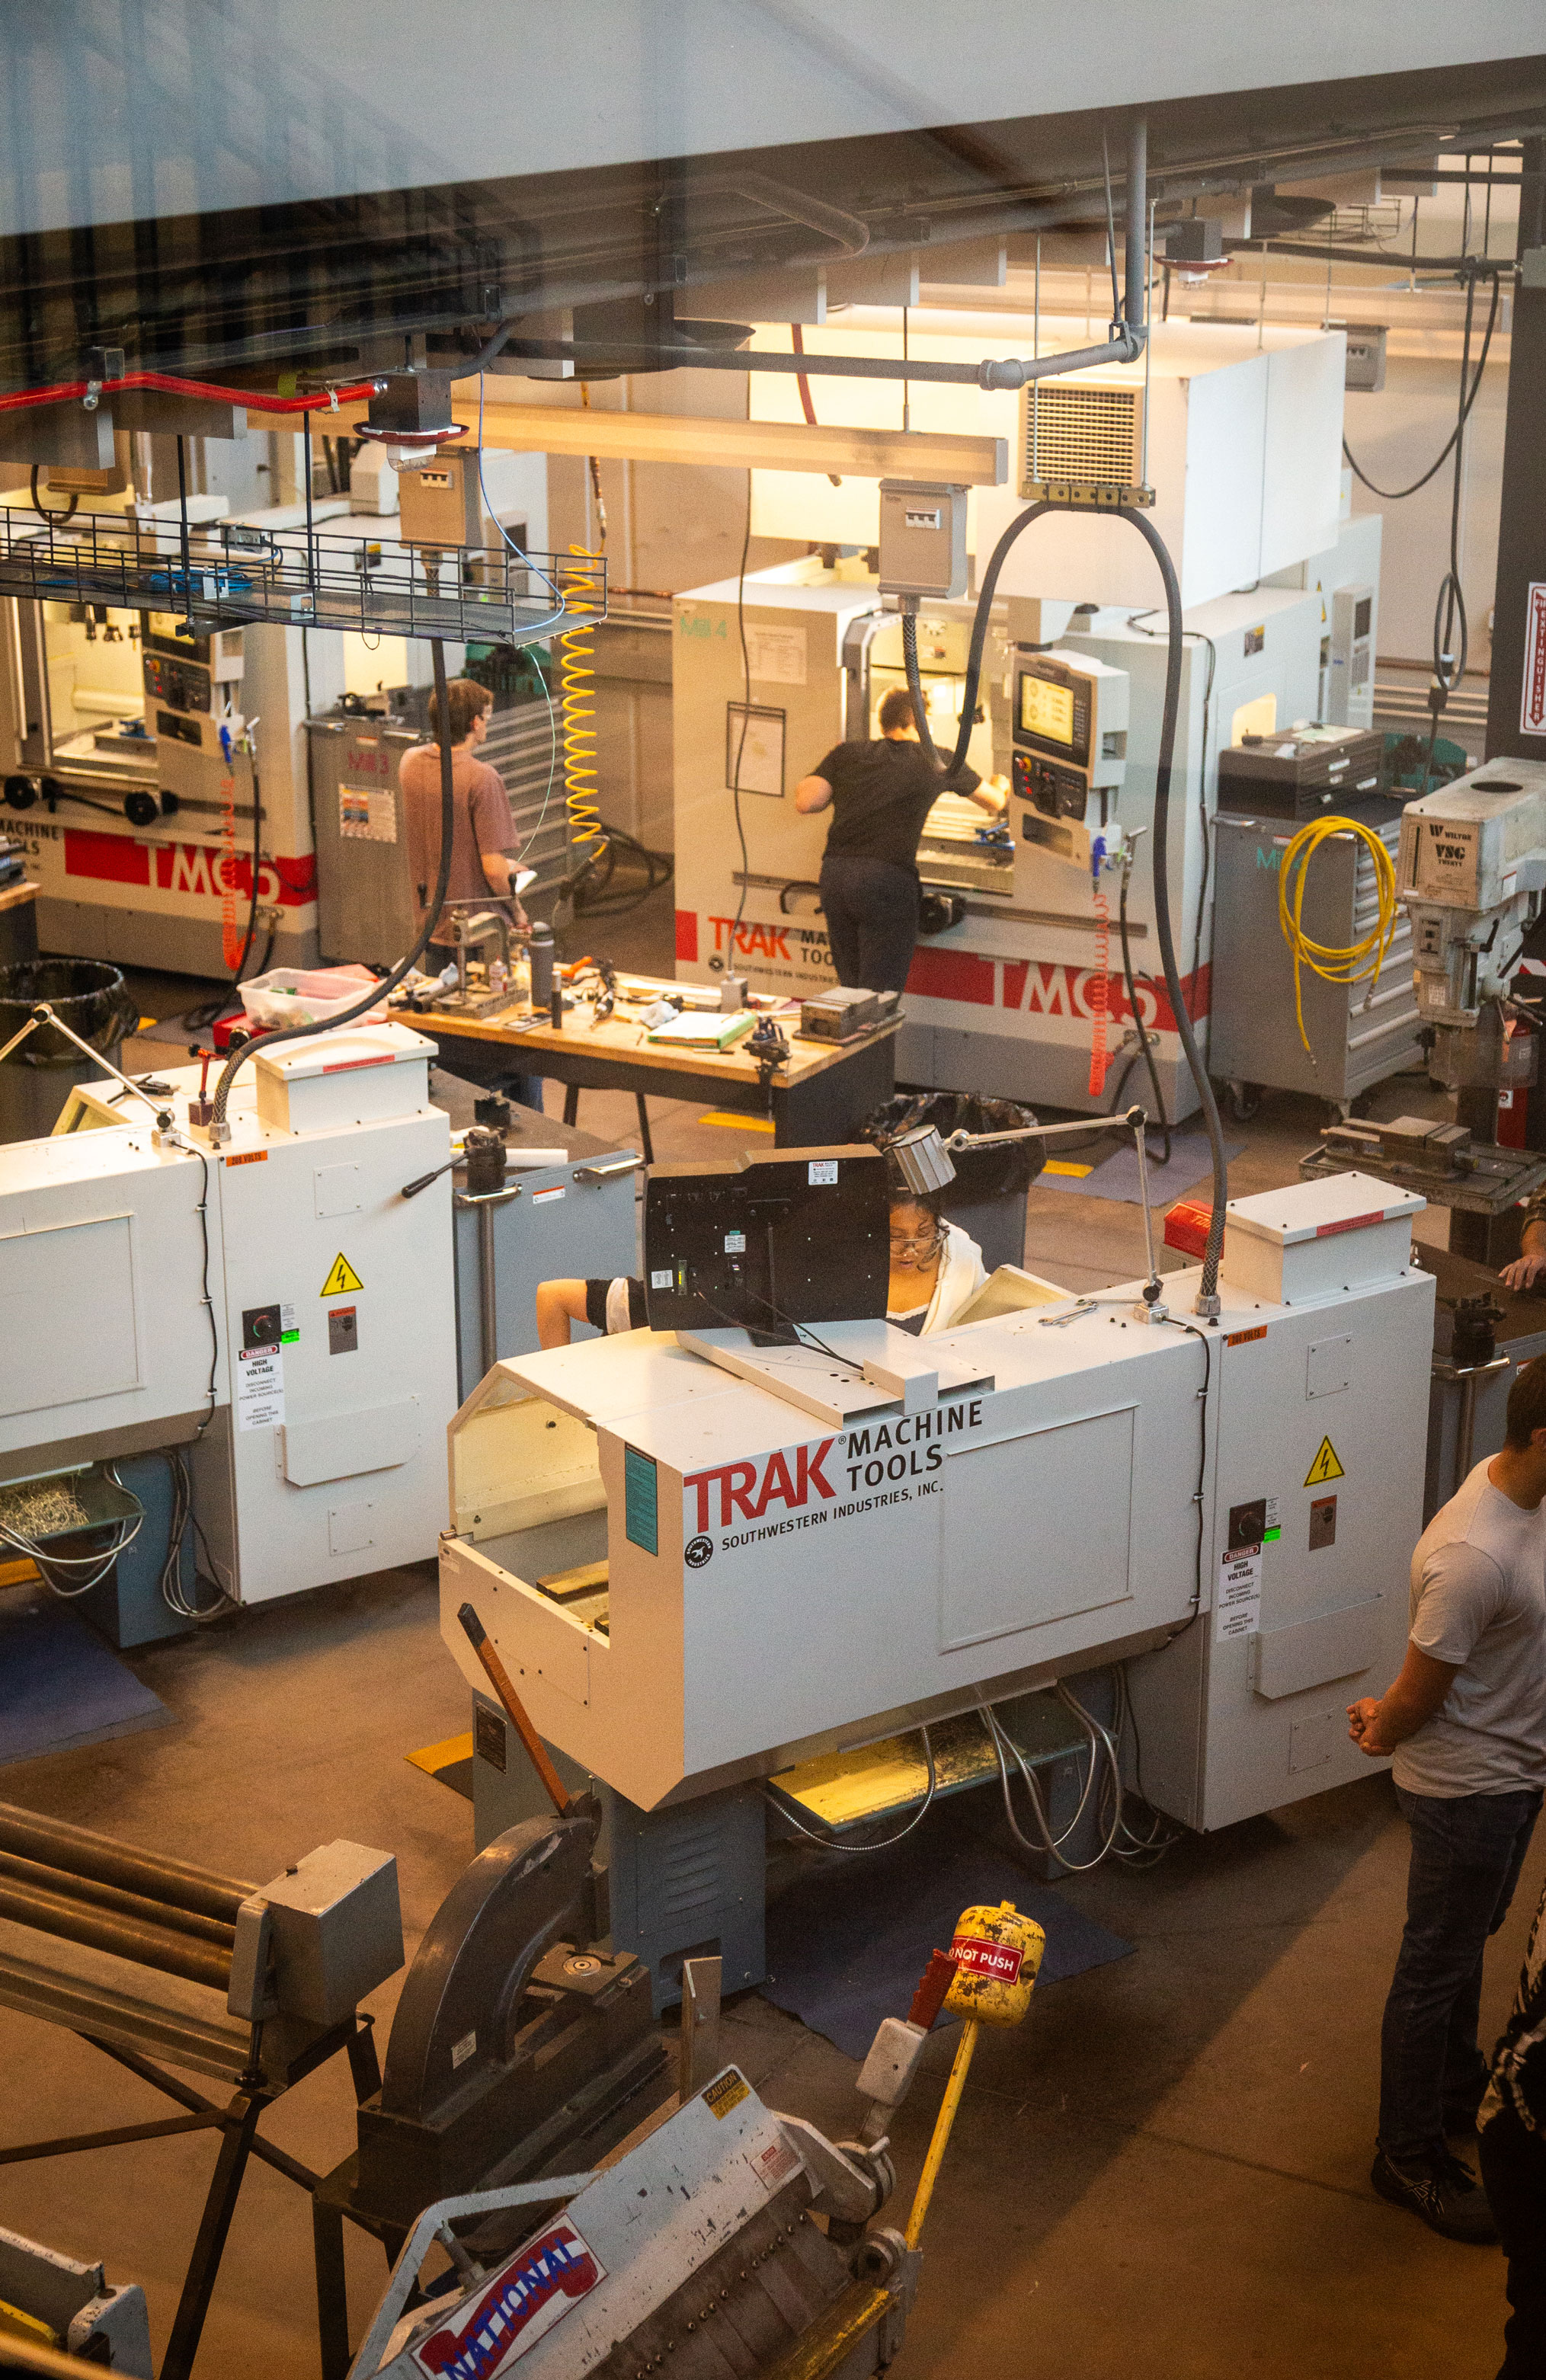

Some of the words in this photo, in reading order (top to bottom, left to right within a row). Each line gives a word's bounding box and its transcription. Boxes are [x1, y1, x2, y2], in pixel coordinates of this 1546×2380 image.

[1534, 610, 1546, 721] EXTINGUISHER
[708, 916, 792, 961] TRAK
[246, 1347, 273, 1358] DANGER
[246, 1365, 274, 1376] VOLTAGE
[245, 1378, 276, 1387] DISCONNECT
[245, 1412, 267, 1420] OPENING
[683, 1437, 837, 1534] TRAK
[847, 1400, 983, 1459] MACHINE
[847, 1444, 943, 1492] TOOLS
[721, 1511, 827, 1551] SOUTHWESTERN
[833, 1488, 913, 1521] INDUSTRIES,
[917, 1480, 943, 1497] INC.
[1229, 1548, 1254, 1559] DANGER
[1234, 1560, 1248, 1571] HIGH
[1228, 1568, 1253, 1581] VOLTAGE
[1225, 1582, 1254, 1595] DISCONNECT
[1228, 1590, 1250, 1600] INCOMING
[1219, 1601, 1235, 1609] POWER
[1230, 1613, 1248, 1622] BEFORE
[1223, 1620, 1243, 1630] OPENING
[1228, 1626, 1248, 1635] CABINET
[955, 1948, 979, 1962] NOT
[980, 1953, 1014, 1972] PUSH
[706, 2072, 738, 2103] CAUTION
[440, 2237, 584, 2380] NATIONAL
